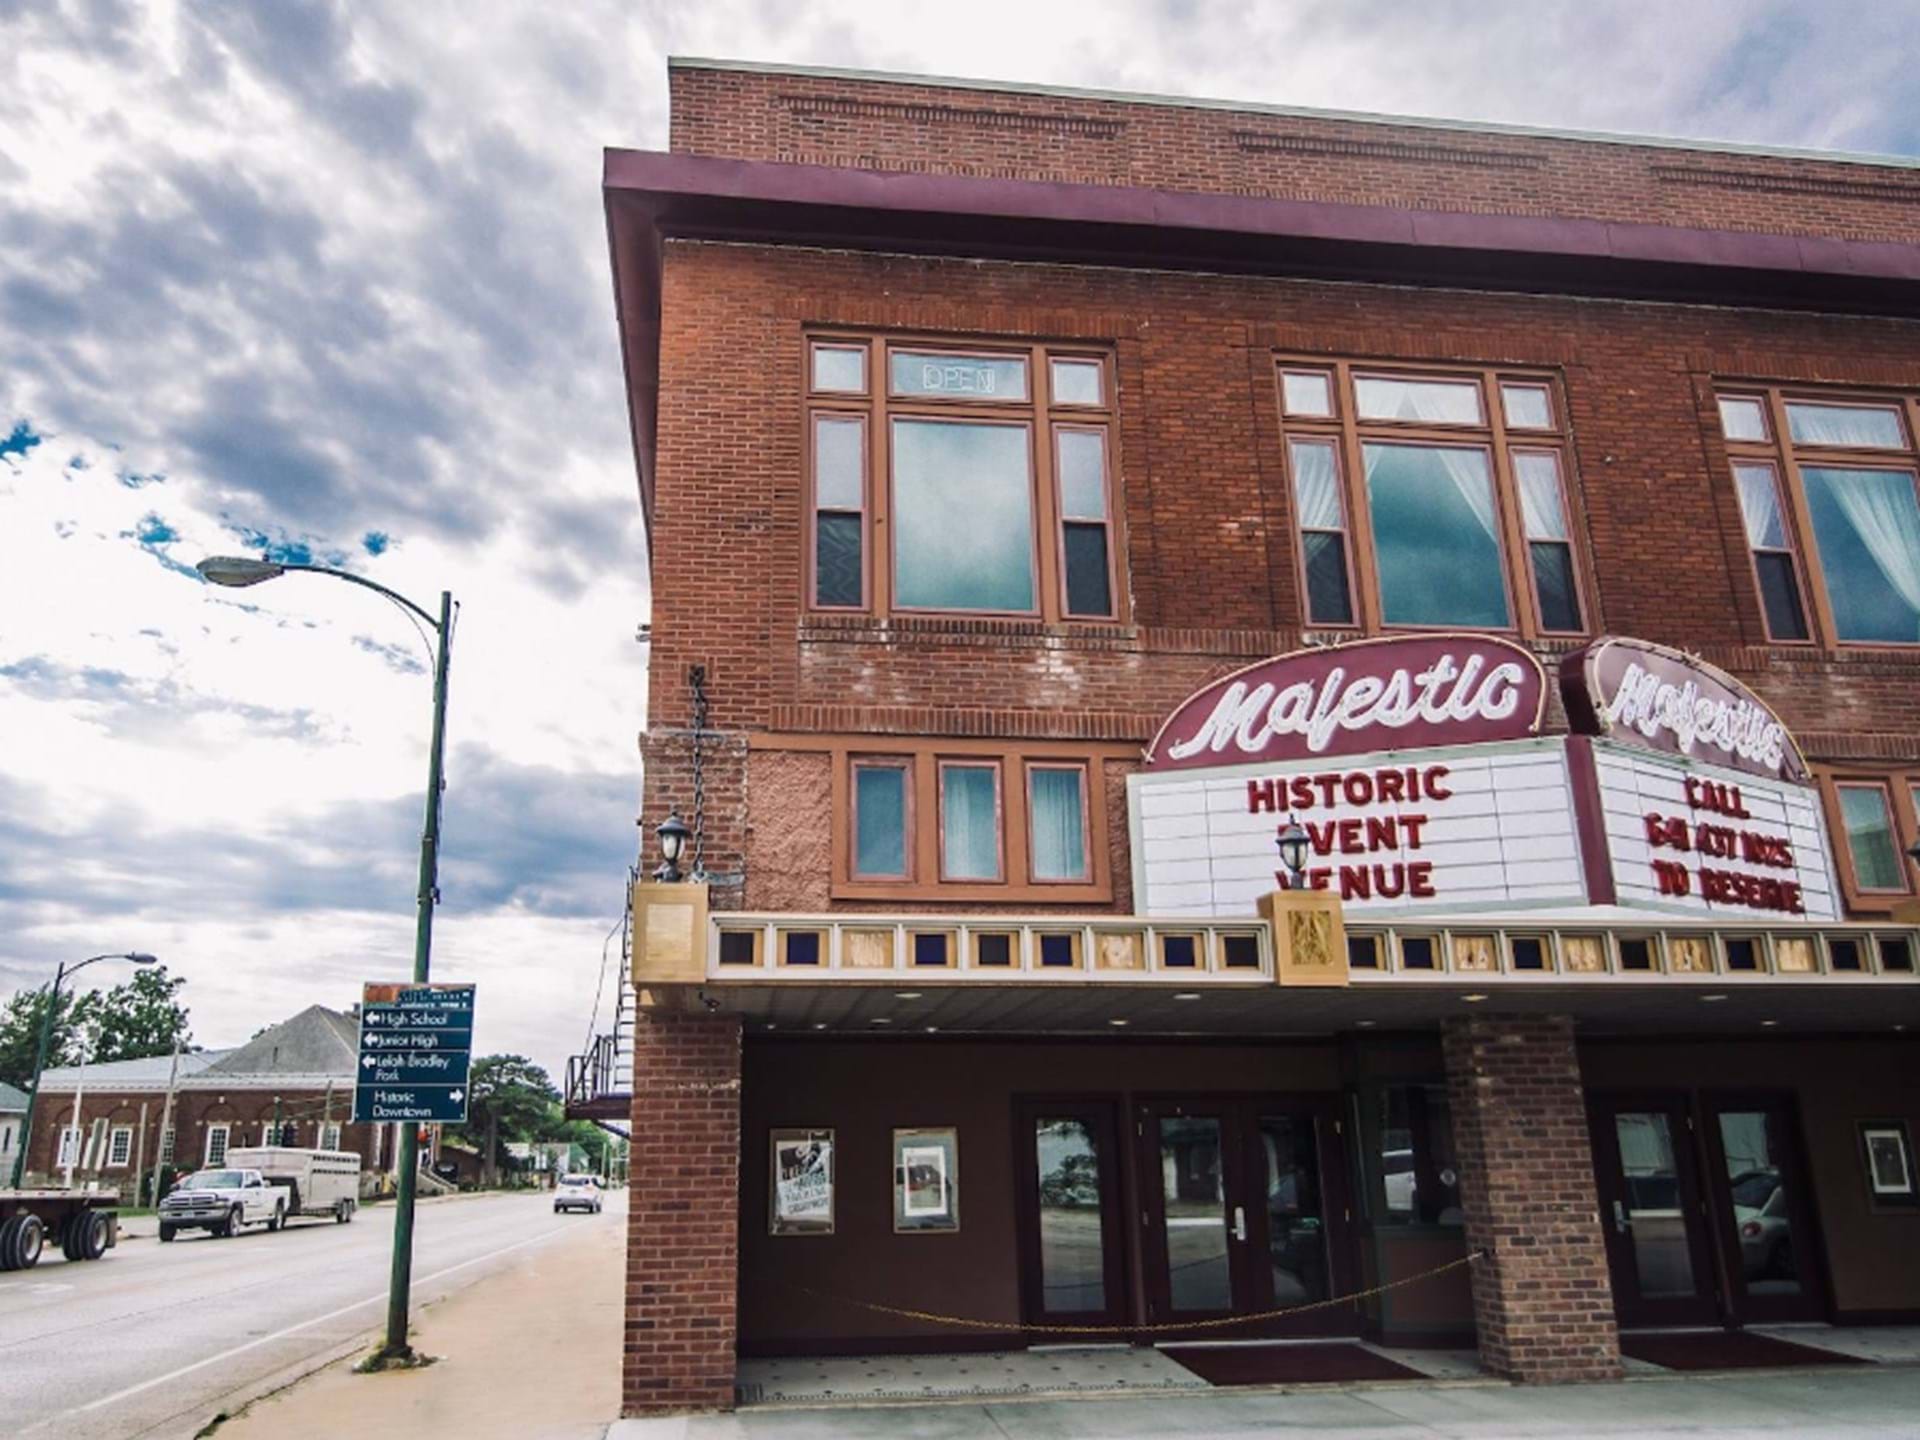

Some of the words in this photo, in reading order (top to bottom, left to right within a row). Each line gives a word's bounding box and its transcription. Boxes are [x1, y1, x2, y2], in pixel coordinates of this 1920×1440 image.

[923, 364, 995, 393] OPEN
[1168, 653, 1524, 760] Majestic
[1605, 663, 1784, 770] Majestic
[1247, 765, 1452, 814] HISTORIC
[1685, 776, 1750, 820] CALL
[1277, 815, 1428, 857] VENT
[1651, 858, 1691, 897] TO
[1699, 866, 1806, 915] RESERVE
[381, 1013, 408, 1029] High
[411, 1012, 447, 1025] School
[377, 1034, 408, 1047] Junior
[411, 1033, 438, 1049] High
[375, 1069, 400, 1081] Park
[408, 1053, 449, 1069] Bradley
[372, 1105, 432, 1117] Downtown
[374, 1090, 415, 1103] Historic
